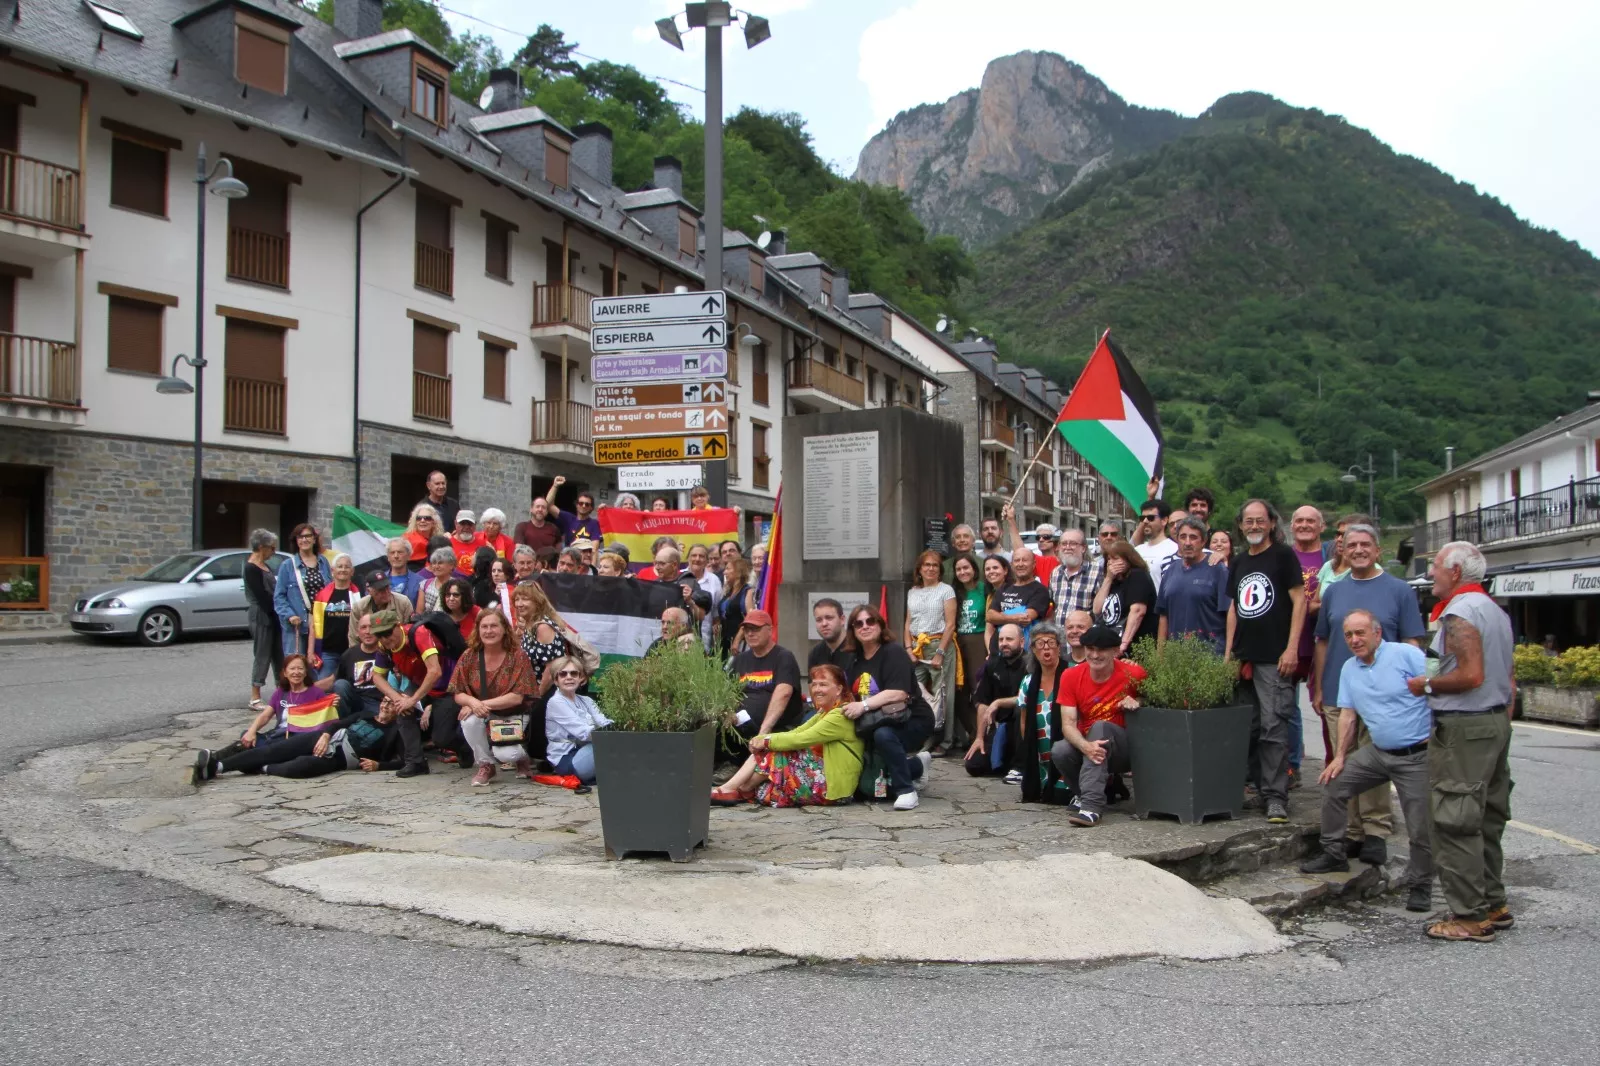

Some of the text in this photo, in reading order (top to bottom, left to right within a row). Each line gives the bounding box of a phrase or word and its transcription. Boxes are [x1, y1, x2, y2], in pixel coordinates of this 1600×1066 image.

[596, 303, 650, 316] JAVIERRE
[596, 332, 654, 344] ESPIERBA
[596, 360, 612, 369] Arte
[618, 358, 656, 367] Naturaleza
[596, 387, 633, 396] Valle de
[596, 396, 637, 407] Pineta
[594, 410, 683, 423] pista esquí de fondo
[594, 423, 623, 432] 14 Km
[598, 441, 631, 449] parador
[598, 447, 679, 461] Monte Perdido
[626, 480, 653, 488] hasta
